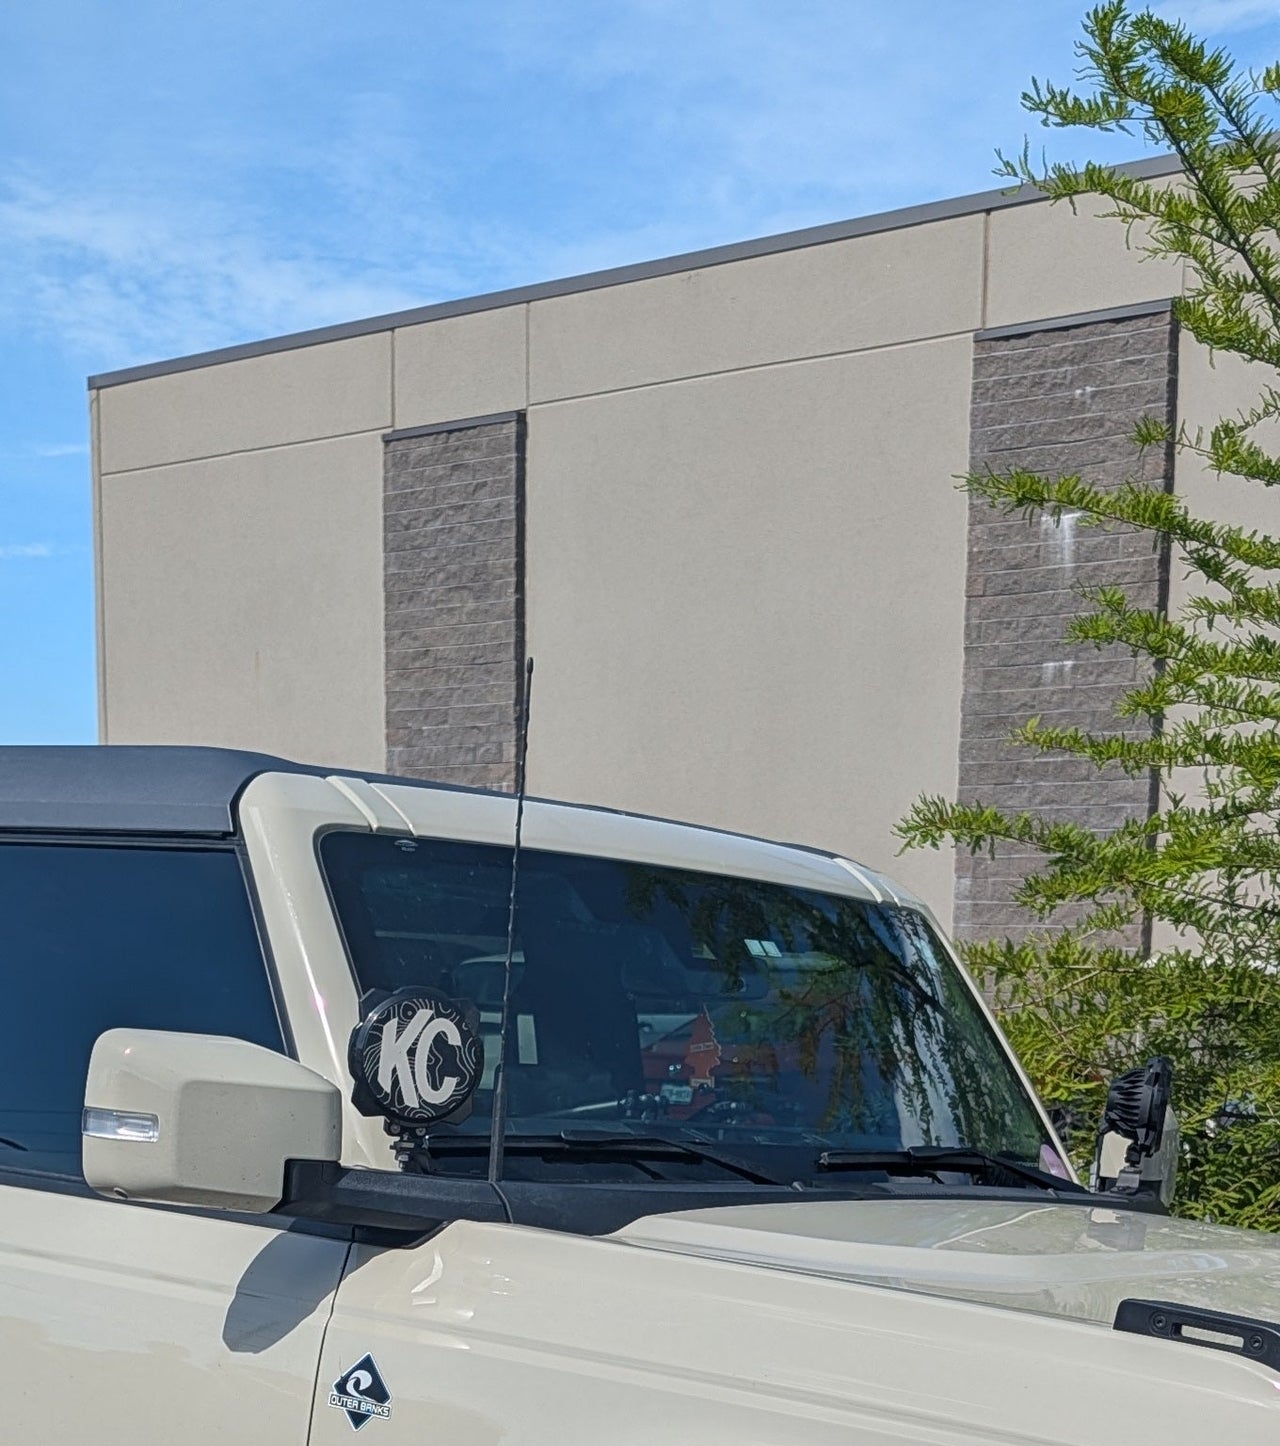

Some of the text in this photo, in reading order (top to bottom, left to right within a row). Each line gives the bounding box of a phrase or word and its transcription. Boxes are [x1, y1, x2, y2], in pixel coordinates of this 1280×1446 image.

[378, 1009, 462, 1108] KC
[330, 1395, 390, 1417] OUTER BANKS
